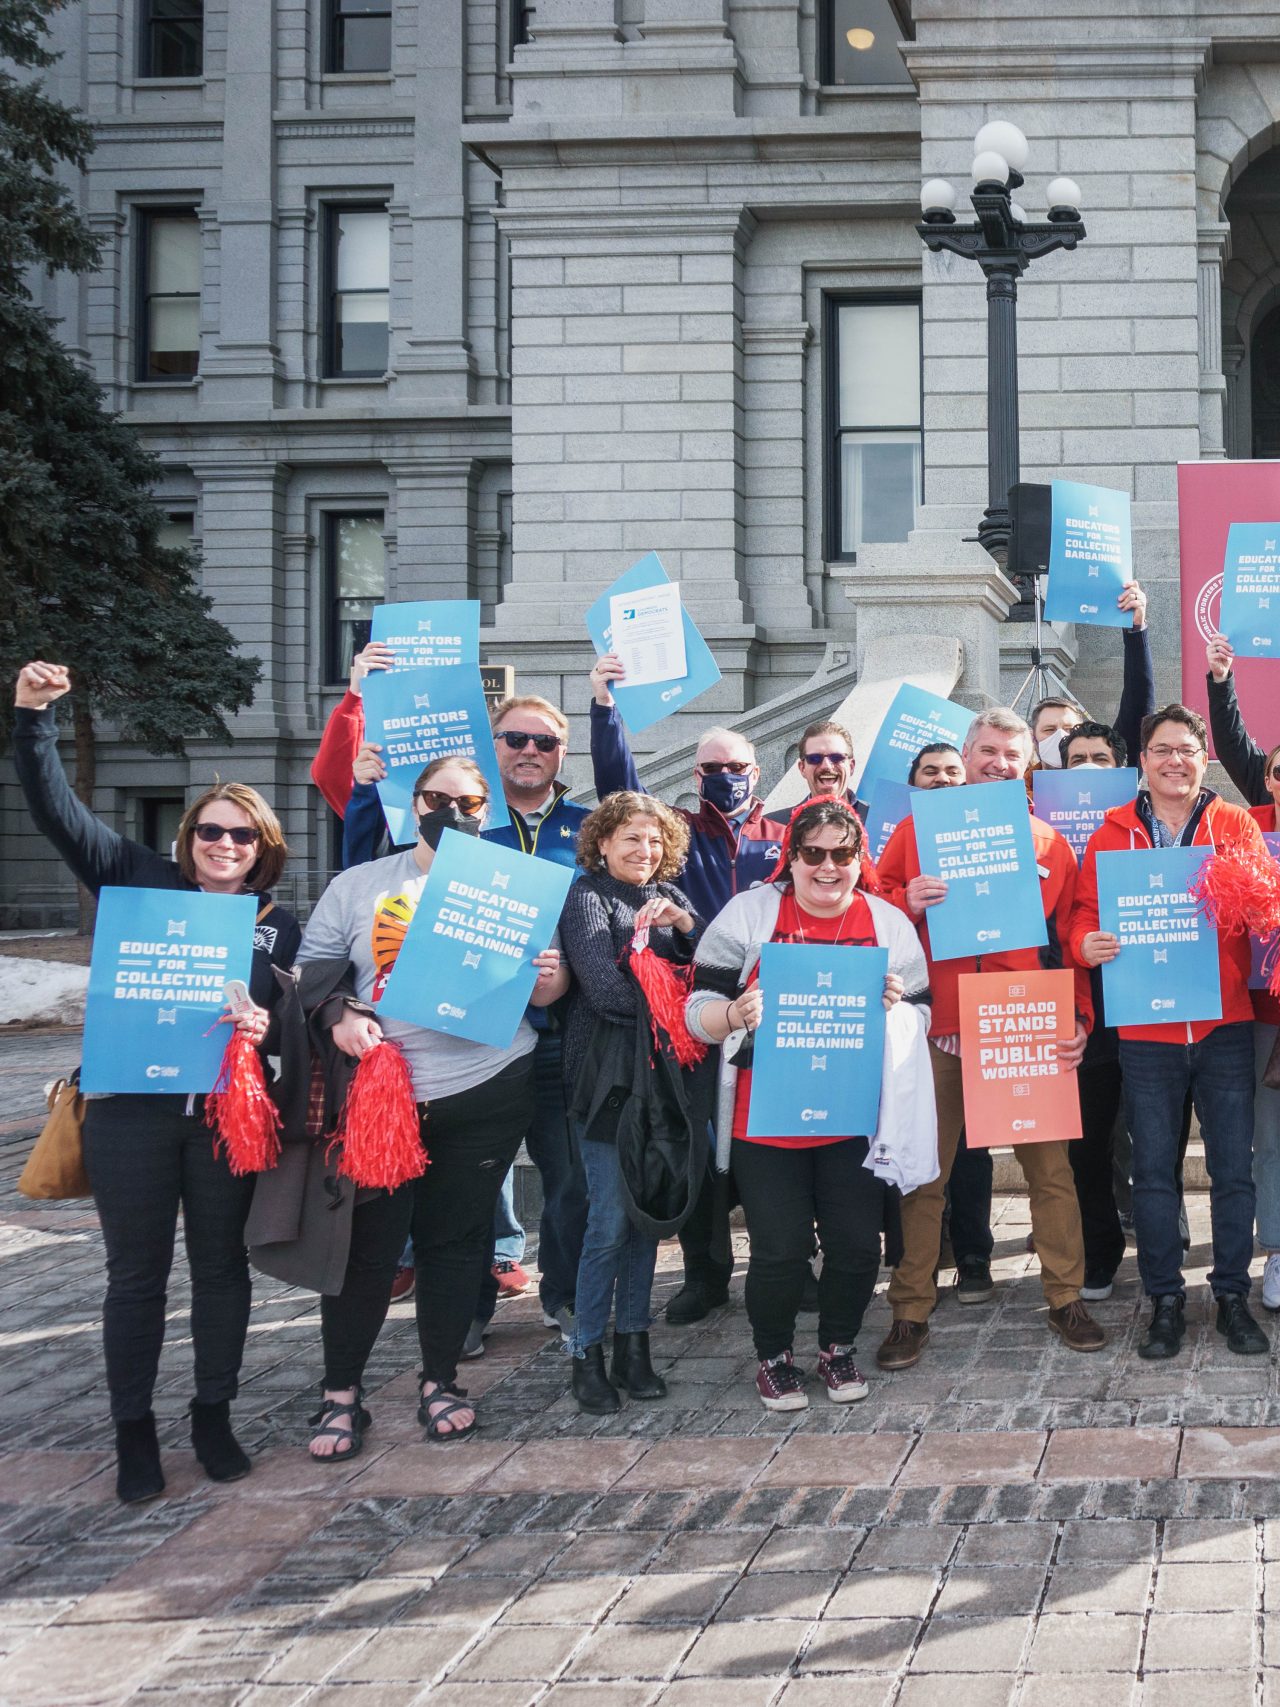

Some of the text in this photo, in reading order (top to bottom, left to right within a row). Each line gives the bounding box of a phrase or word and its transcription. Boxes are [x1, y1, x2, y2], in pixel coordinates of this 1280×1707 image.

[1066, 518, 1120, 533] EDUCATORS
[1086, 531, 1101, 540] FOR
[1065, 539, 1121, 554] COLLECTIVE
[1065, 549, 1121, 563] BARGAINING
[1200, 582, 1219, 614] WORKERS
[387, 636, 462, 645] EDUCATORS
[383, 710, 469, 730] EDUCATORS
[899, 713, 959, 741] EDUCATORS
[416, 727, 439, 738] FOR
[917, 728, 933, 739] FOR
[387, 734, 474, 755] COLLECTIVE
[390, 746, 476, 767] BARGAINING
[1050, 810, 1105, 821] EDUCATO
[934, 824, 1014, 844] EDUCATORS
[1076, 823, 1095, 831] FOR
[966, 841, 987, 851] FOR
[939, 848, 1017, 868] COLLECTIVE
[941, 861, 1019, 880] BARGAINING
[447, 879, 541, 919] EDUCATORS
[476, 905, 502, 921] FOR
[1148, 908, 1168, 917] FOR
[437, 907, 530, 945] COLLECTIVE
[1119, 918, 1198, 932] COLLECTIVE
[433, 922, 524, 958] BARGAINING
[1121, 931, 1199, 945] BARGAINING
[119, 942, 229, 958] EDUCATORS
[158, 959, 187, 969] FOR
[116, 971, 225, 987] COLLECTIVE
[114, 987, 223, 1002] BARGAINING
[778, 994, 867, 1007] EDUCATORS
[811, 1010, 834, 1018] FOR
[978, 1001, 1056, 1016] COLORADO
[777, 1022, 865, 1034] COLLECTIVE
[979, 1015, 1057, 1034] STANDS
[776, 1037, 864, 1049] BARGAINING
[1004, 1034, 1033, 1044] WITH
[980, 1044, 1057, 1065] PUBLIC
[982, 1064, 1059, 1080] WORKERS
